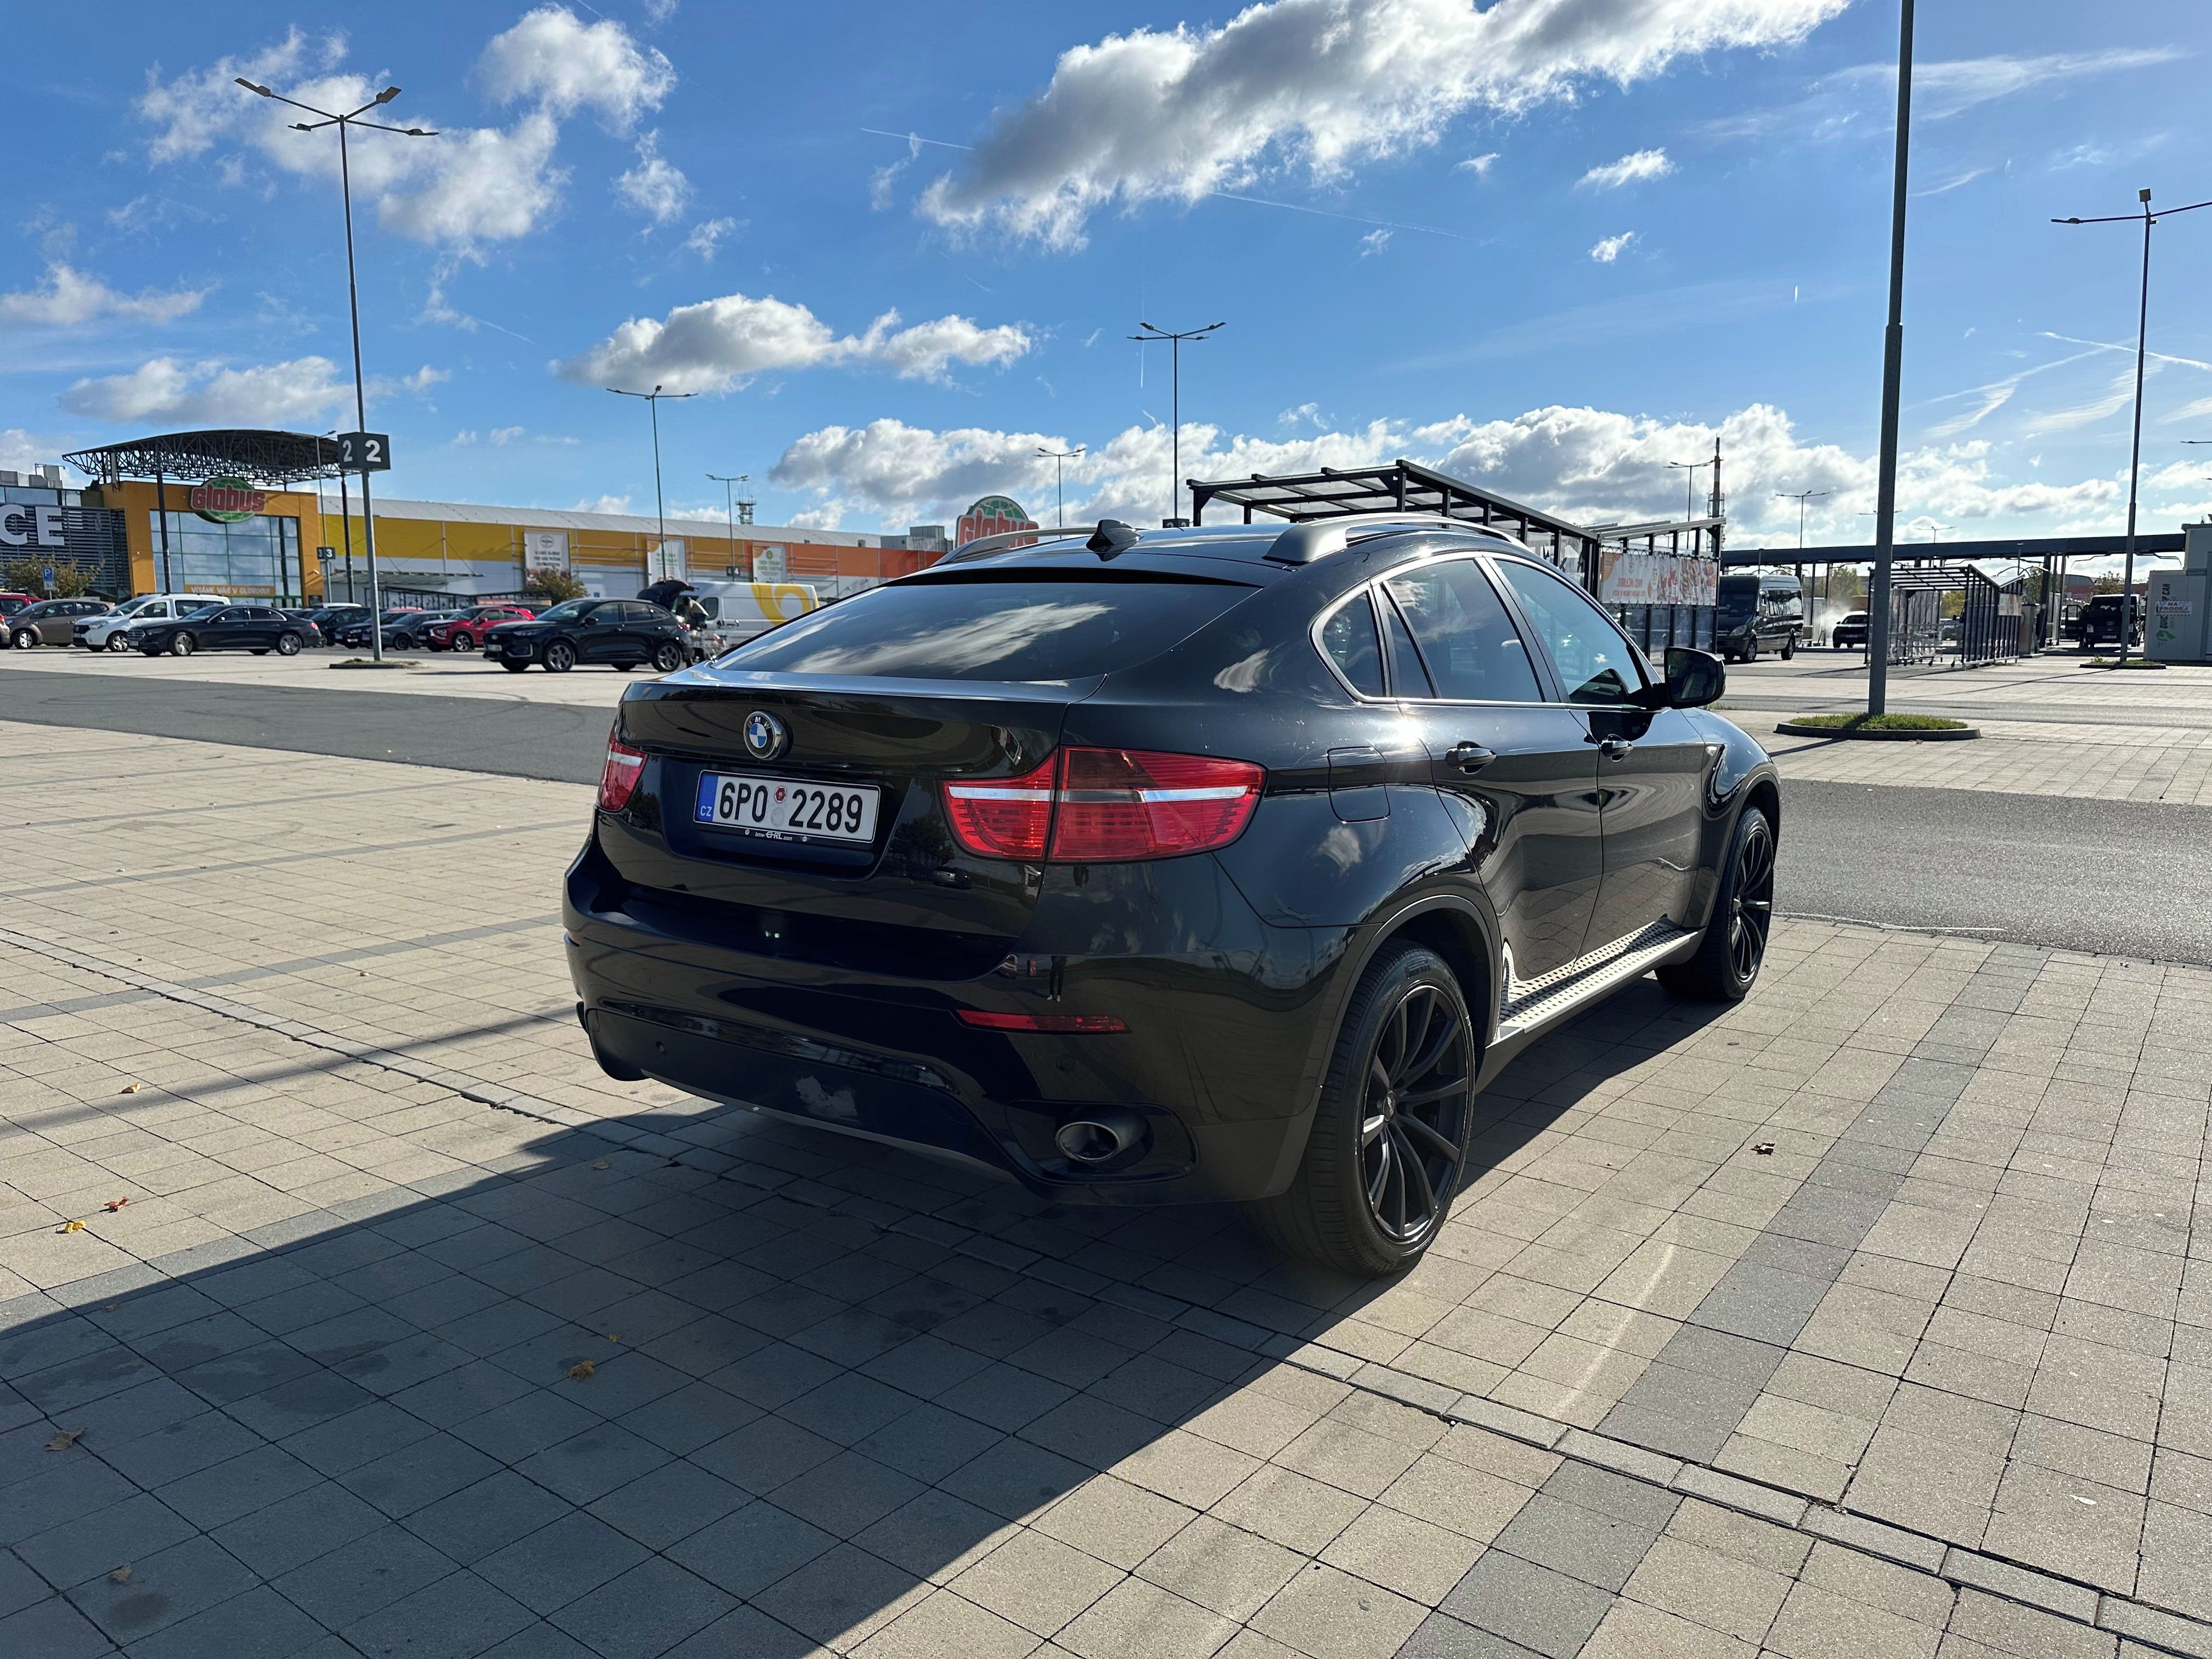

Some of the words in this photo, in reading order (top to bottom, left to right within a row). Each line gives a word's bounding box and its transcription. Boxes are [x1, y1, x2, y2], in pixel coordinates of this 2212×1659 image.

[342, 440, 353, 462] 2
[365, 439, 381, 462] 2
[192, 484, 266, 512] Globus
[326, 548, 332, 557] 3
[44, 569, 51, 577] P
[748, 716, 771, 730] BMW
[700, 805, 711, 816] CZ
[788, 789, 863, 833] 2289
